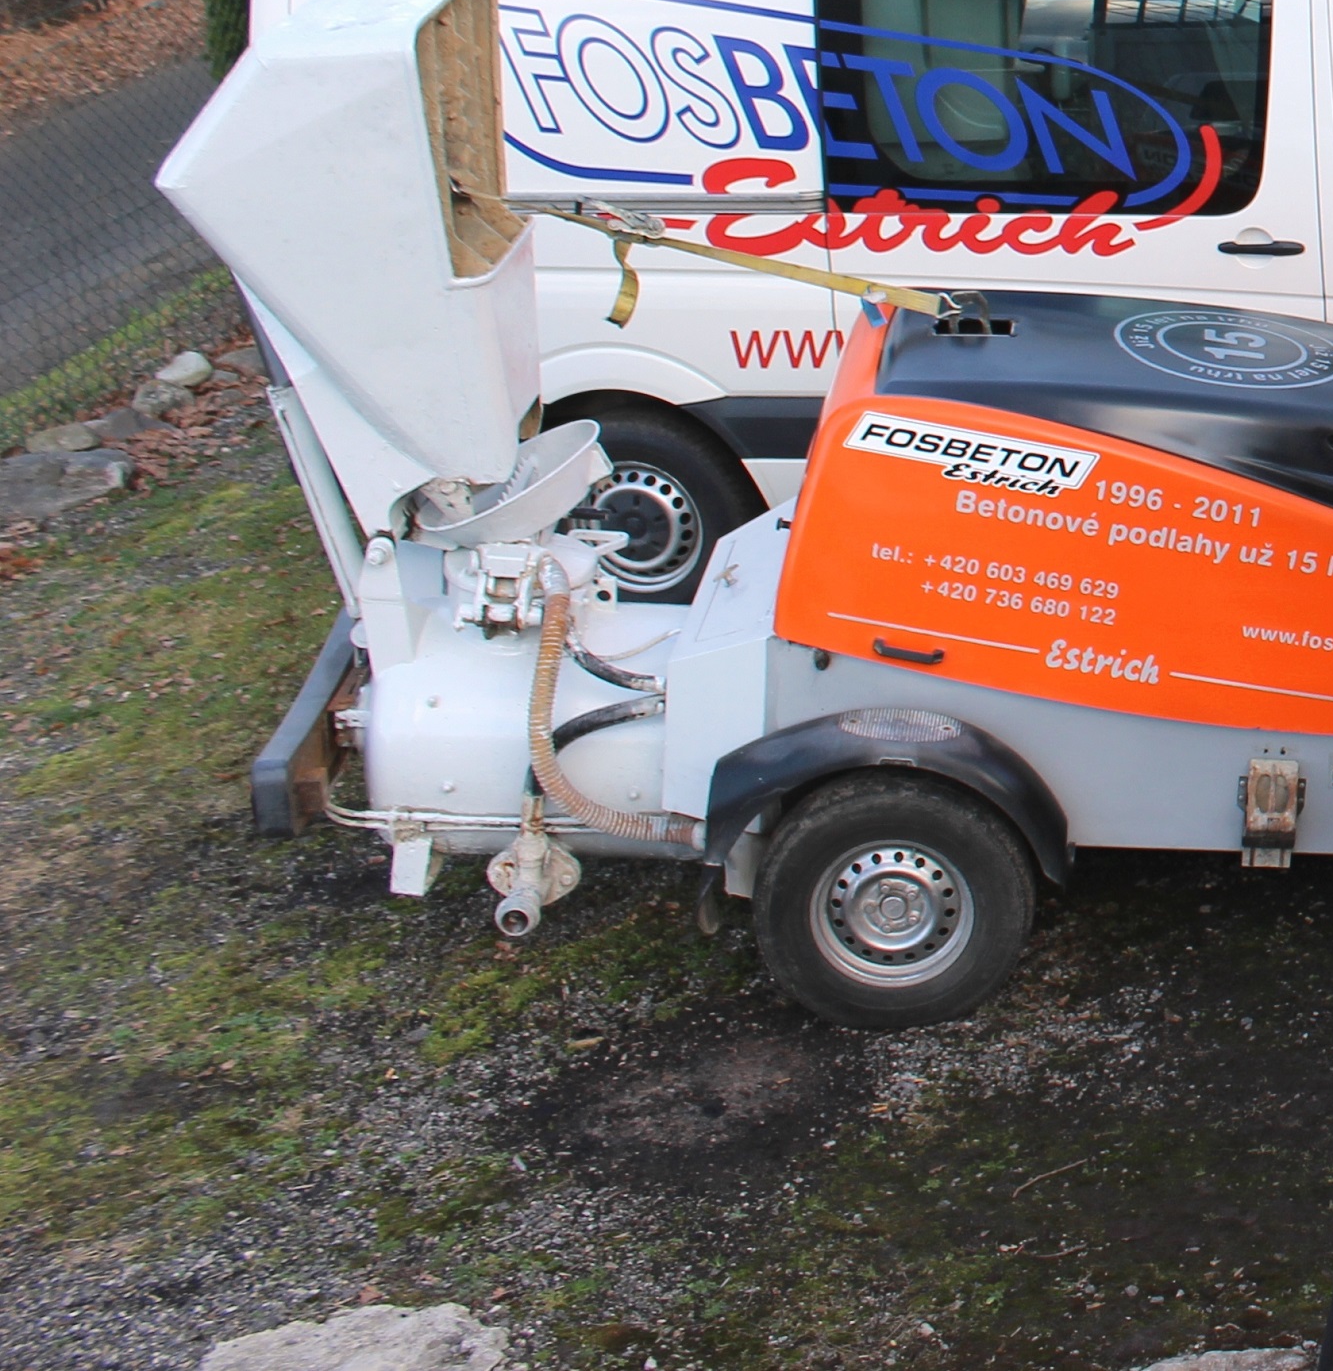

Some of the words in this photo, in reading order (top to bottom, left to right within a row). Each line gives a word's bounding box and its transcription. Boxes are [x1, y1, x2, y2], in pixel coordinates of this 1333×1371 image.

[500, 4, 1137, 181] FOSBETON
[699, 157, 1138, 257] Estrich
[1204, 328, 1267, 361] 15
[860, 423, 1081, 479] FOSBETON
[943, 463, 1062, 495] Estrich
[1095, 480, 1164, 511] 1996
[1192, 496, 1262, 527] 2011
[955, 489, 1101, 536] Betonové
[1108, 522, 1230, 564] podlahy
[1239, 542, 1275, 567] už
[1286, 549, 1318, 575] 15
[871, 543, 914, 565] tel.:
[924, 554, 980, 576] +420
[986, 562, 1027, 584] 603
[1033, 570, 1073, 591] 469
[1079, 578, 1119, 600] 629
[920, 580, 977, 602] +420
[984, 588, 1023, 610] 736
[1030, 596, 1070, 618] 680
[1079, 605, 1117, 626] 122
[1045, 638, 1160, 684] Estrich
